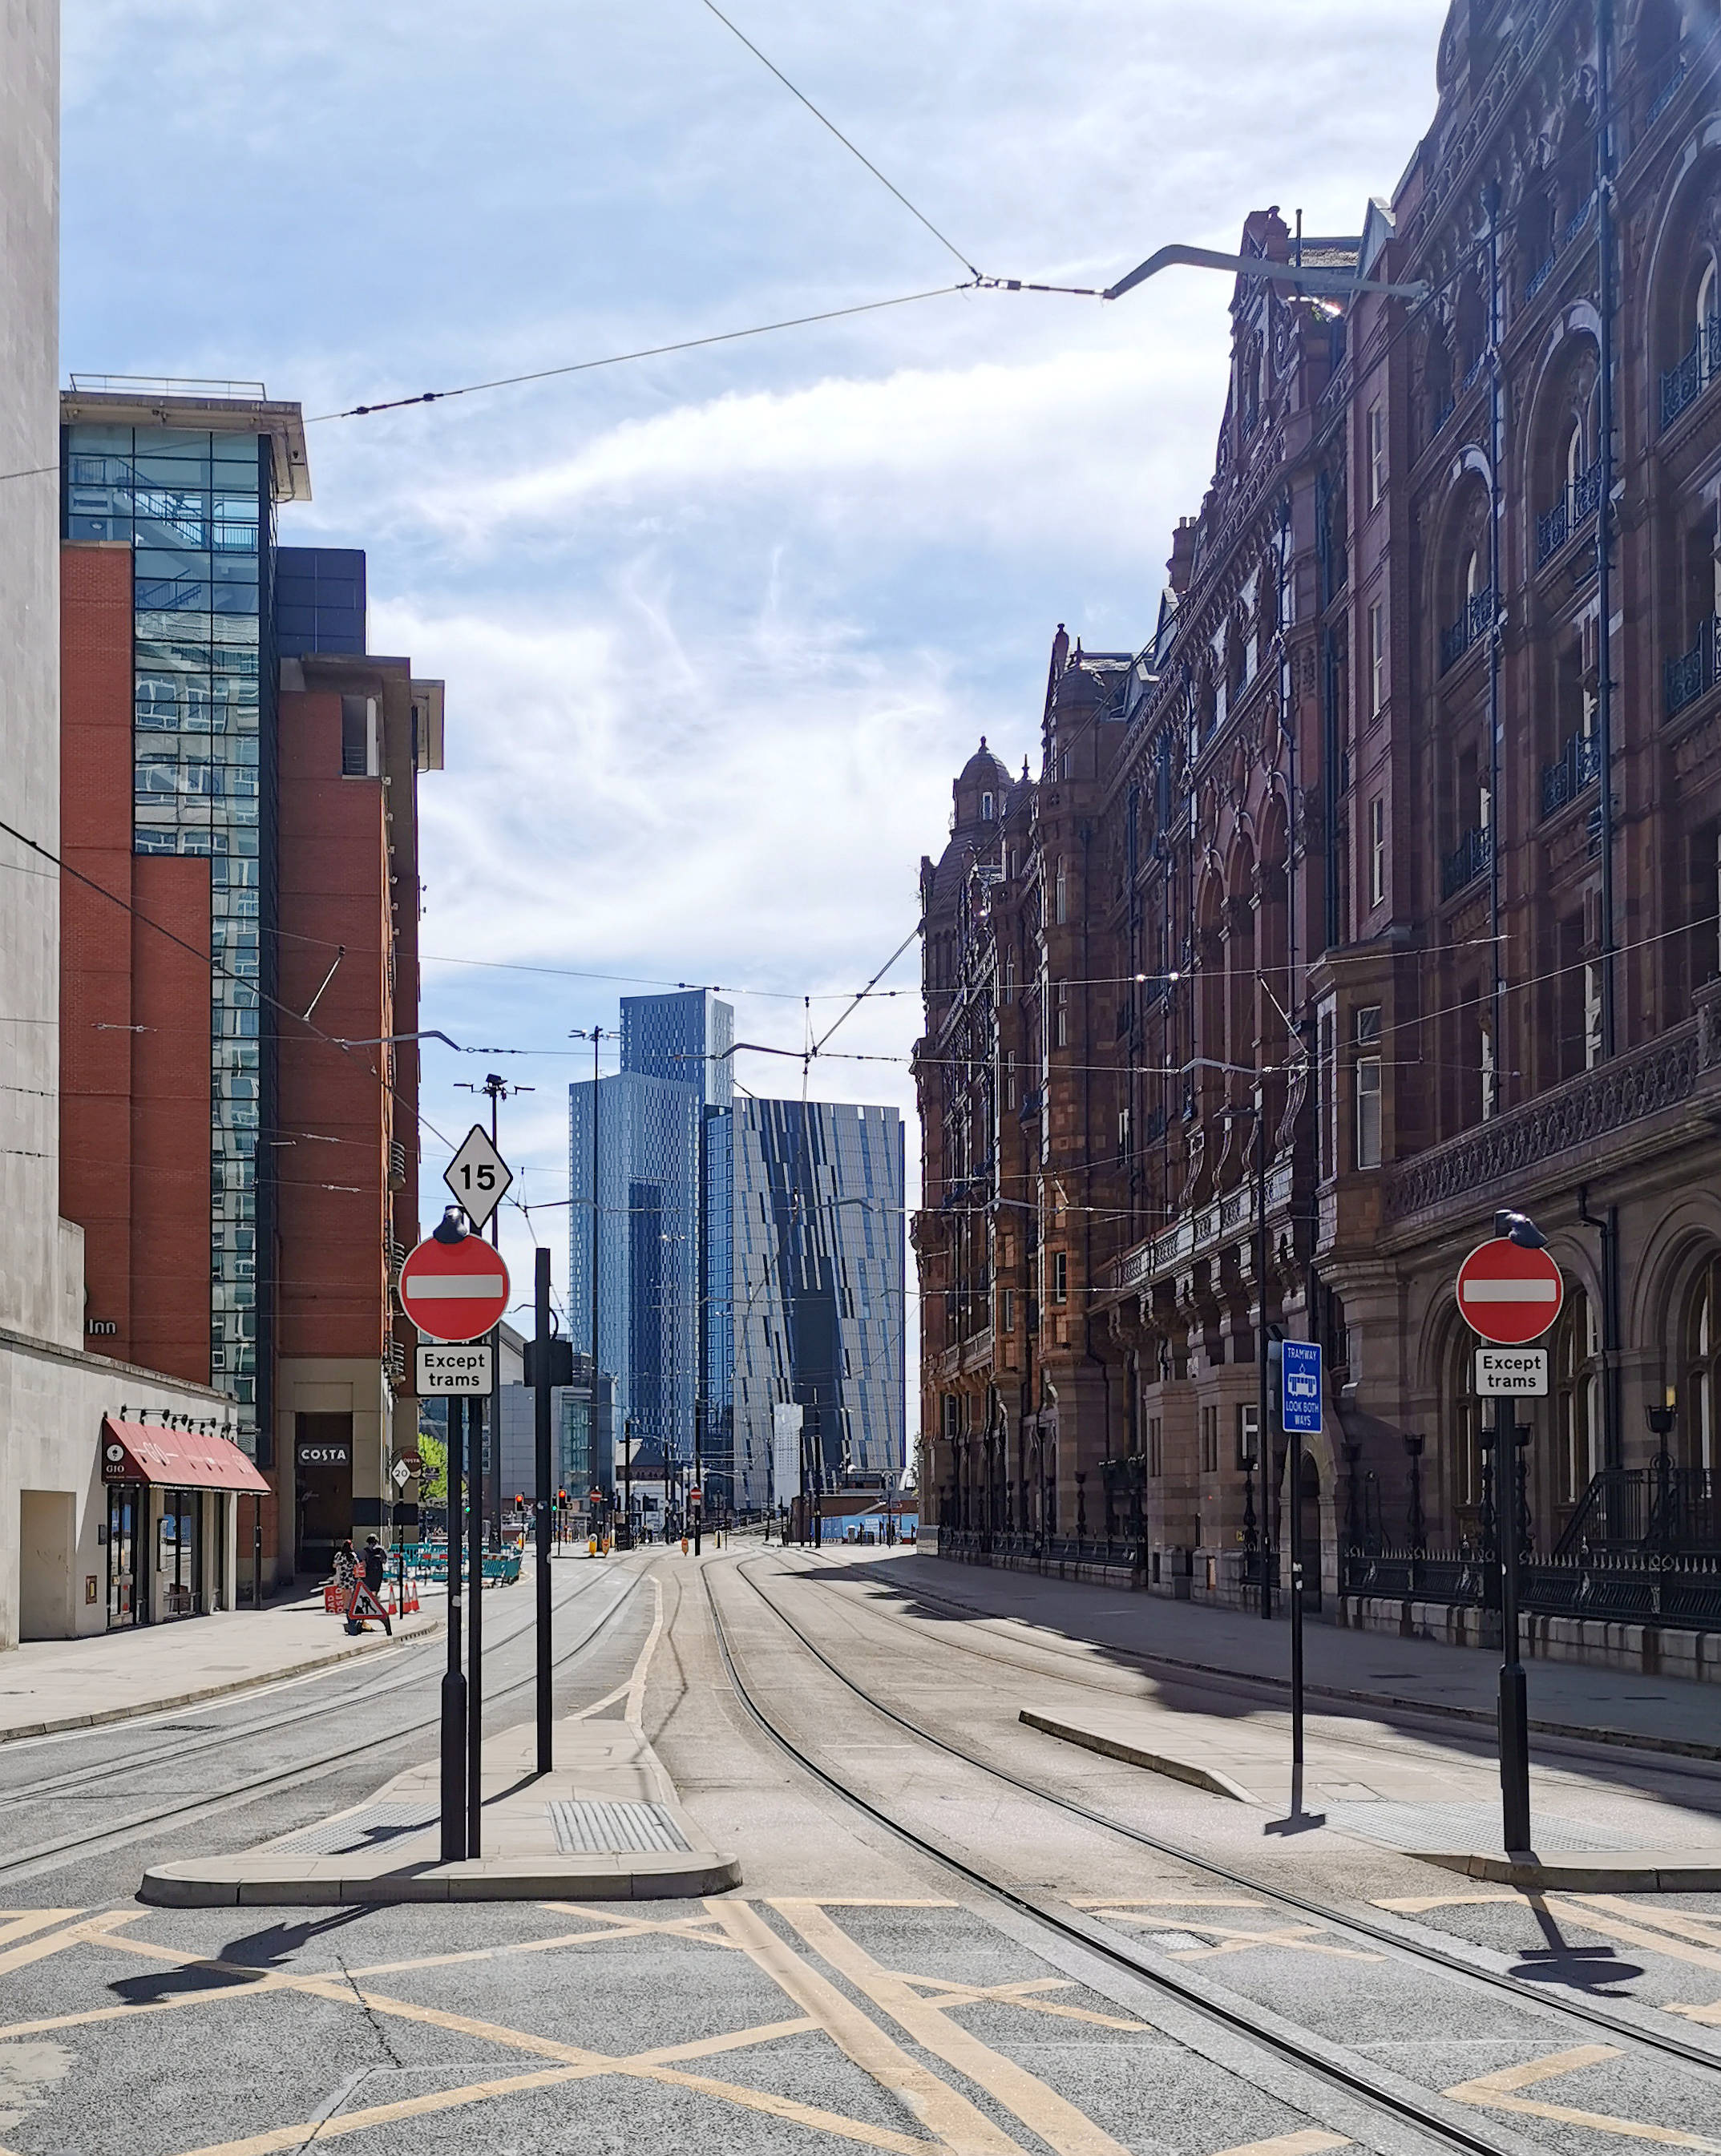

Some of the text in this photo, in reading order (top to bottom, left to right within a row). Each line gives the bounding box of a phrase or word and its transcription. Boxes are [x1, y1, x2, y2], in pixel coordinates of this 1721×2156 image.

[460, 1164, 495, 1191] 15
[89, 1318, 116, 1334] Inn
[1287, 1347, 1317, 1361] TRAMWAY
[424, 1353, 485, 1370] Except
[1483, 1355, 1541, 1372] Except
[428, 1373, 480, 1387] trams
[1487, 1374, 1537, 1387] trams
[1286, 1400, 1319, 1413] LOOK BOTH
[1295, 1415, 1311, 1427] WAYS
[301, 1449, 346, 1461] COSTA
[106, 1464, 125, 1473] GIO
[394, 1469, 408, 1478] 20
